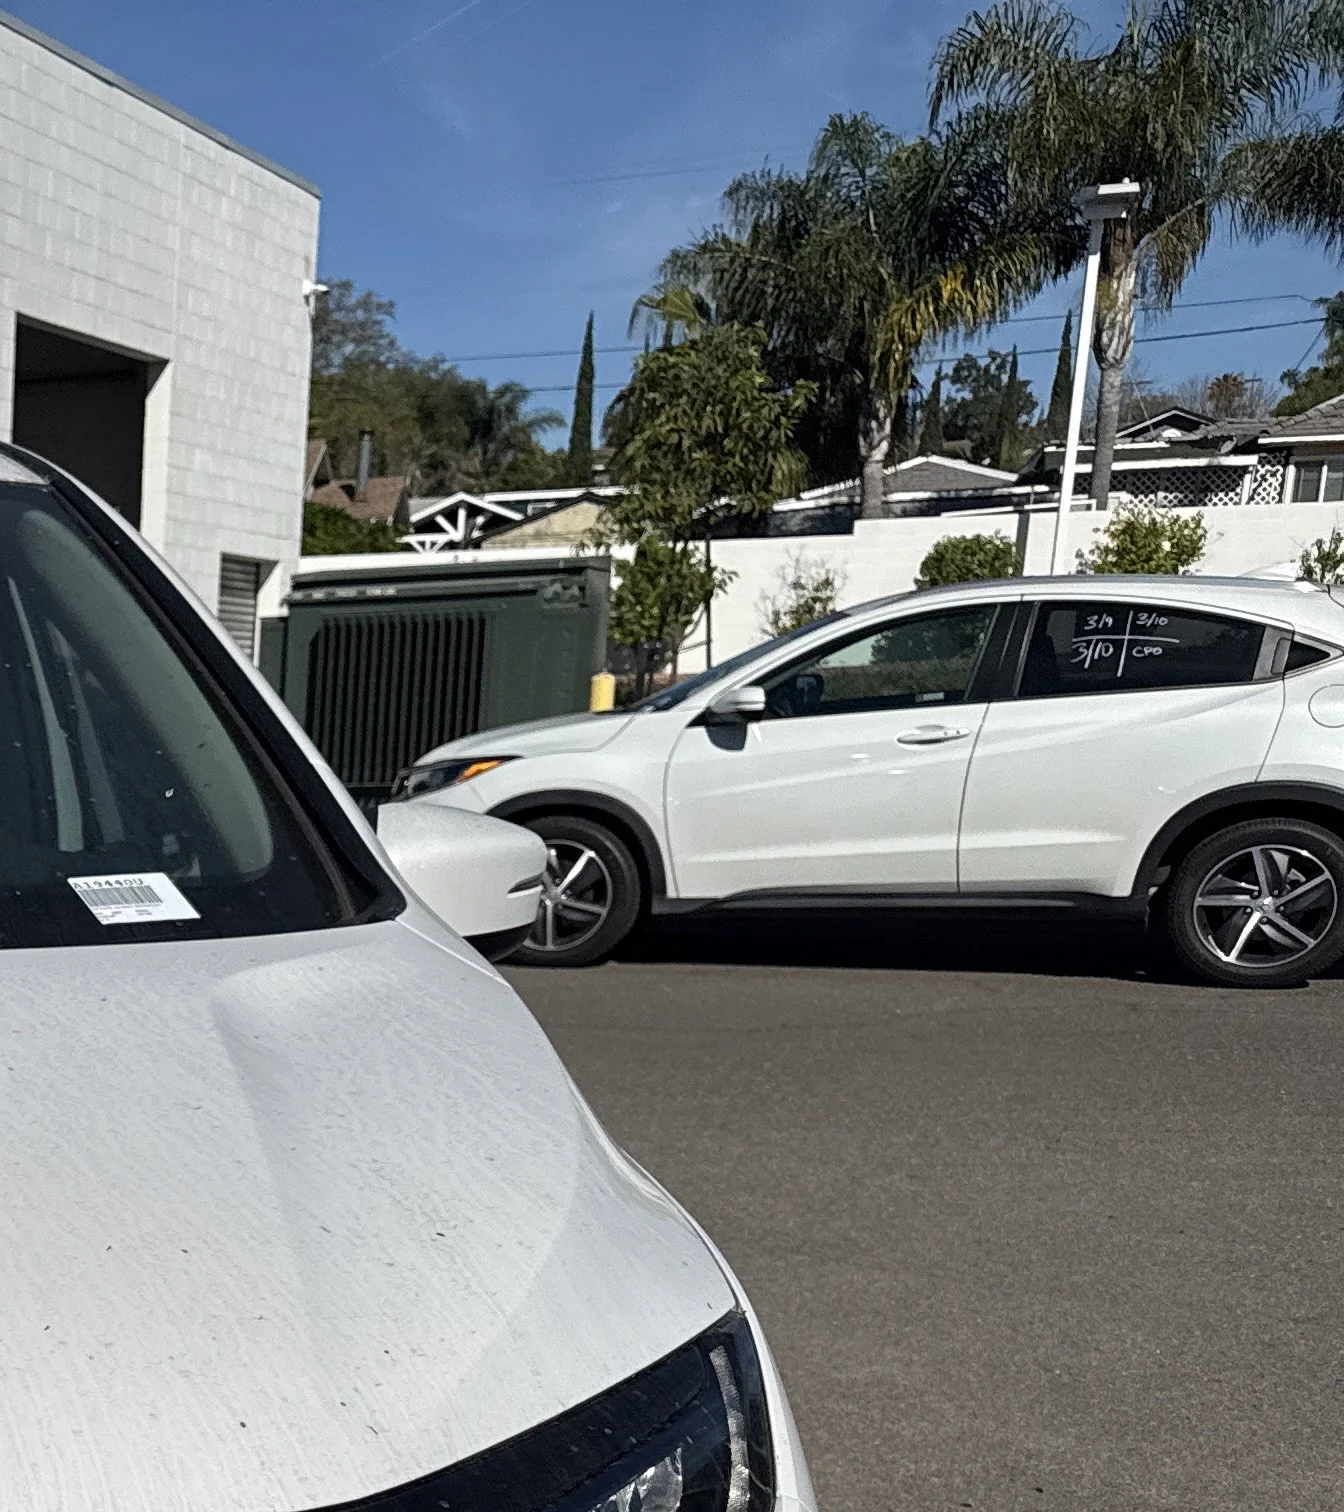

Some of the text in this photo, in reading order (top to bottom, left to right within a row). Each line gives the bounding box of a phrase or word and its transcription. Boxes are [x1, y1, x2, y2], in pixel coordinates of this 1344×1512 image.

[1084, 613, 1113, 630] 3/9
[1071, 638, 1114, 669] 3/10
[1132, 646, 1162, 657] CPO
